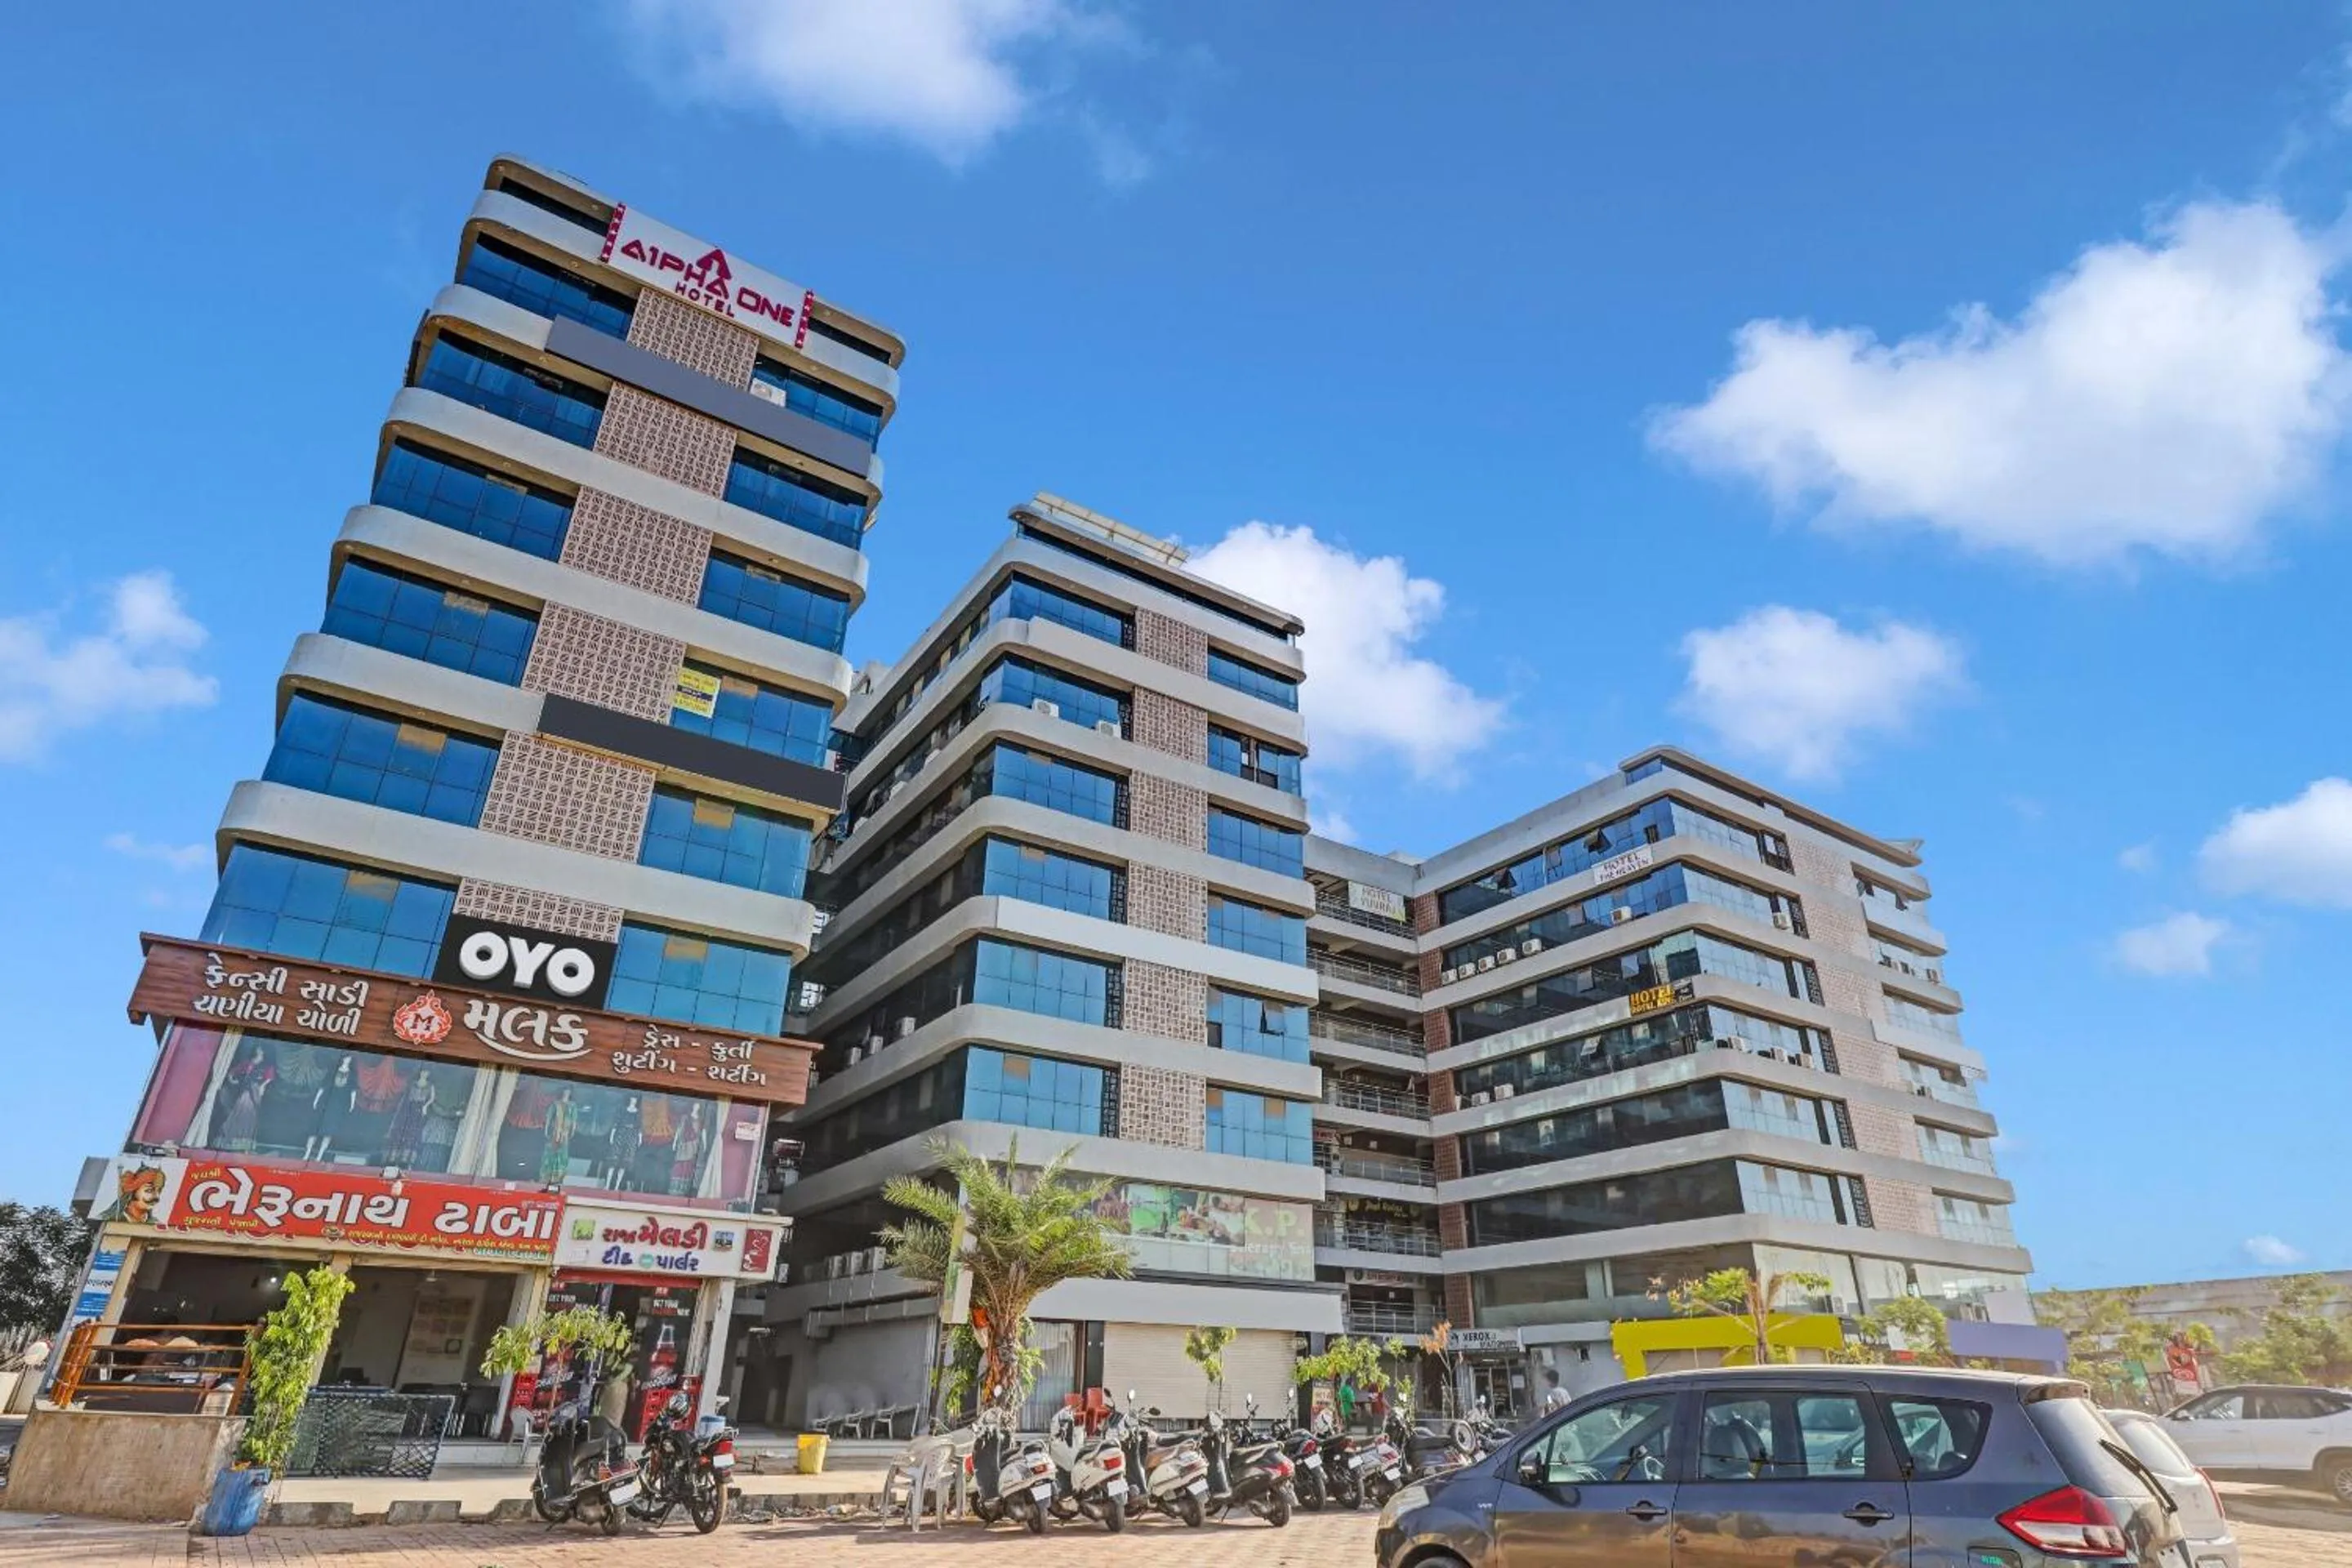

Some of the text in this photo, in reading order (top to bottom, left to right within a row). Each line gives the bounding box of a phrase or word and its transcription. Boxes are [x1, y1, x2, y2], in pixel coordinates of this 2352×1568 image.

[675, 282, 734, 318] HOTEL
[737, 287, 795, 327] ONE
[1603, 853, 1638, 871] HOTEL
[204, 952, 369, 1008] ફેન્સી સાડી
[459, 931, 595, 996] OYO
[1630, 985, 1673, 1006] HOTEL
[296, 1000, 362, 1036] ચોળી
[410, 1013, 435, 1031] M
[463, 1000, 589, 1054] મલક
[642, 1024, 680, 1049] ડ્રેસ
[711, 1040, 756, 1062] કુર્તી
[434, 1202, 557, 1241] ઢાબા
[656, 1251, 700, 1272] પાર્લર
